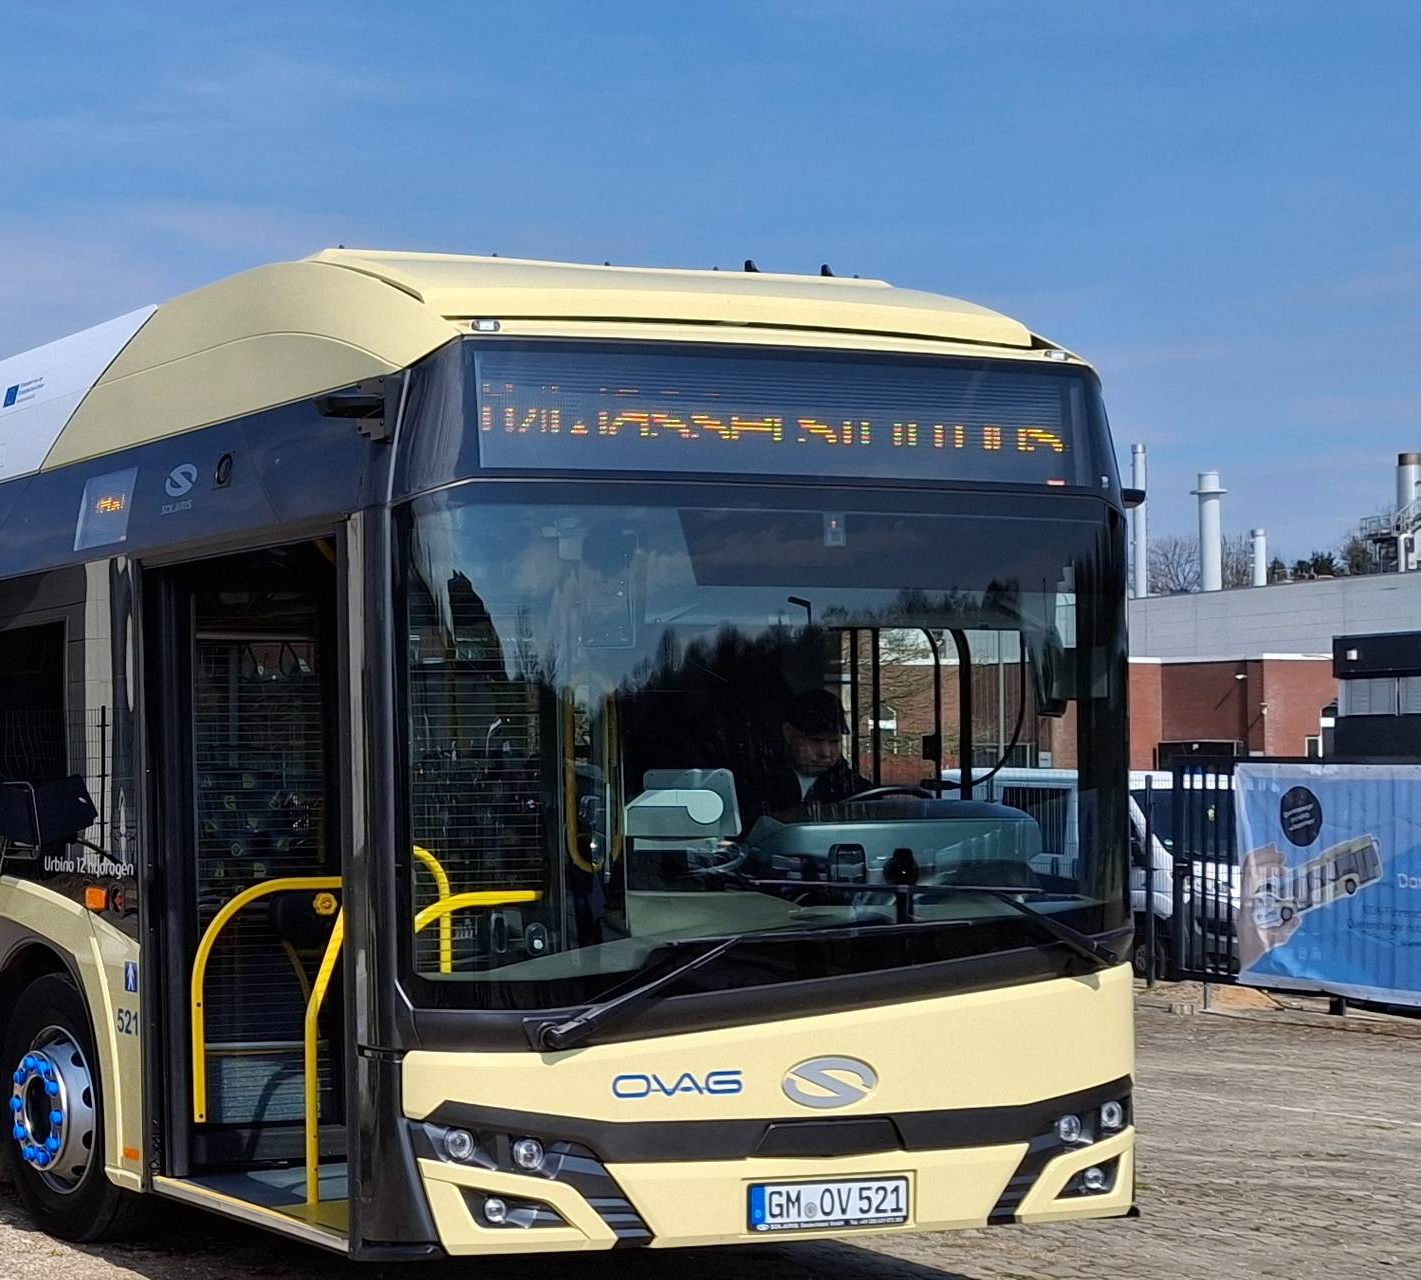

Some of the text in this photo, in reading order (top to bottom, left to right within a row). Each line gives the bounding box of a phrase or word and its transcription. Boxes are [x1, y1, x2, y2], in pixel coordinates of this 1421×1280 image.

[44, 856, 134, 879] Urbino 12 hydrogen
[117, 1008, 138, 1036] 521
[612, 1070, 743, 1098] OVAG
[768, 1184, 903, 1219] GM OV 521
